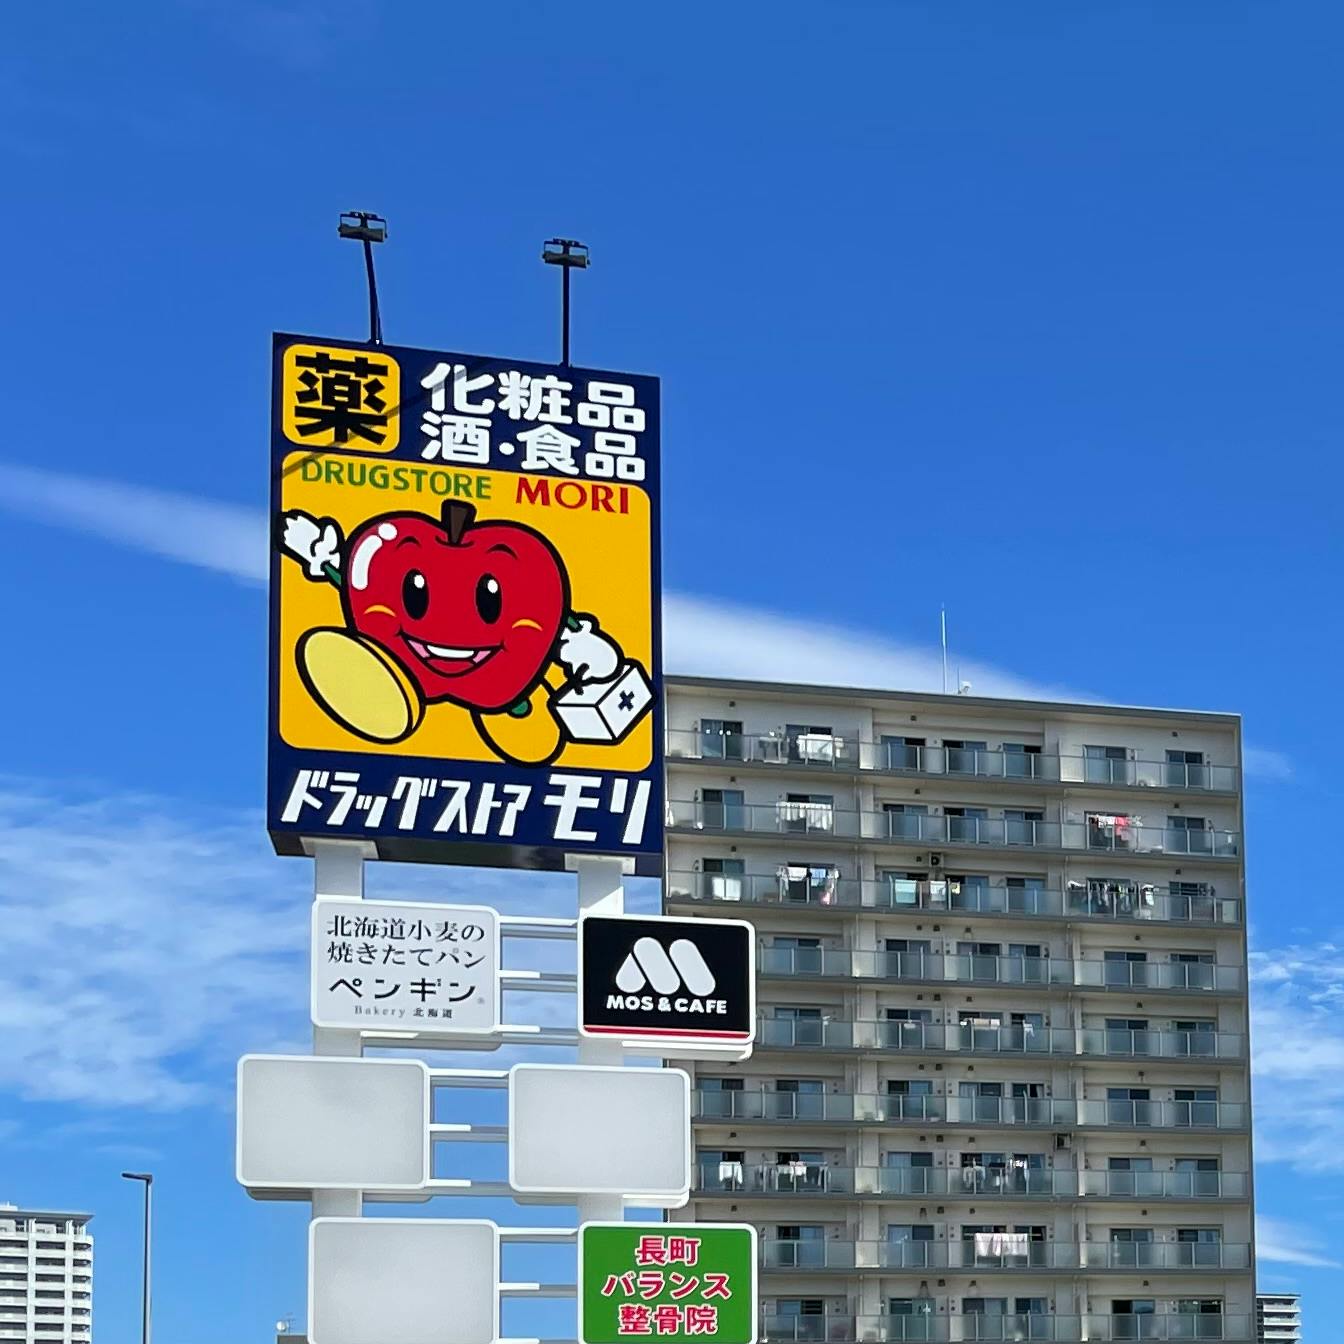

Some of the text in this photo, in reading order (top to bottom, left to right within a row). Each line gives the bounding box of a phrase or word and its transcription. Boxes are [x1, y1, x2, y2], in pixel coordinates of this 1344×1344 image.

[295, 352, 388, 445] 薬
[420, 362, 646, 432] 化粧品
[420, 411, 646, 482] 酒・食品
[302, 457, 630, 515] DRUGSTORE MORI
[280, 769, 653, 846] ドラッグストア モリ
[327, 915, 485, 942] 北海道小麦の
[327, 942, 487, 969] 焼きたてパン
[329, 977, 476, 1003] ペンギン
[606, 995, 727, 1014] MOS & CAFE
[354, 1005, 453, 1019] Bakery 北海道
[635, 1235, 701, 1266] 長町
[601, 1270, 732, 1300] バランス
[618, 1303, 718, 1335] 整骨院
